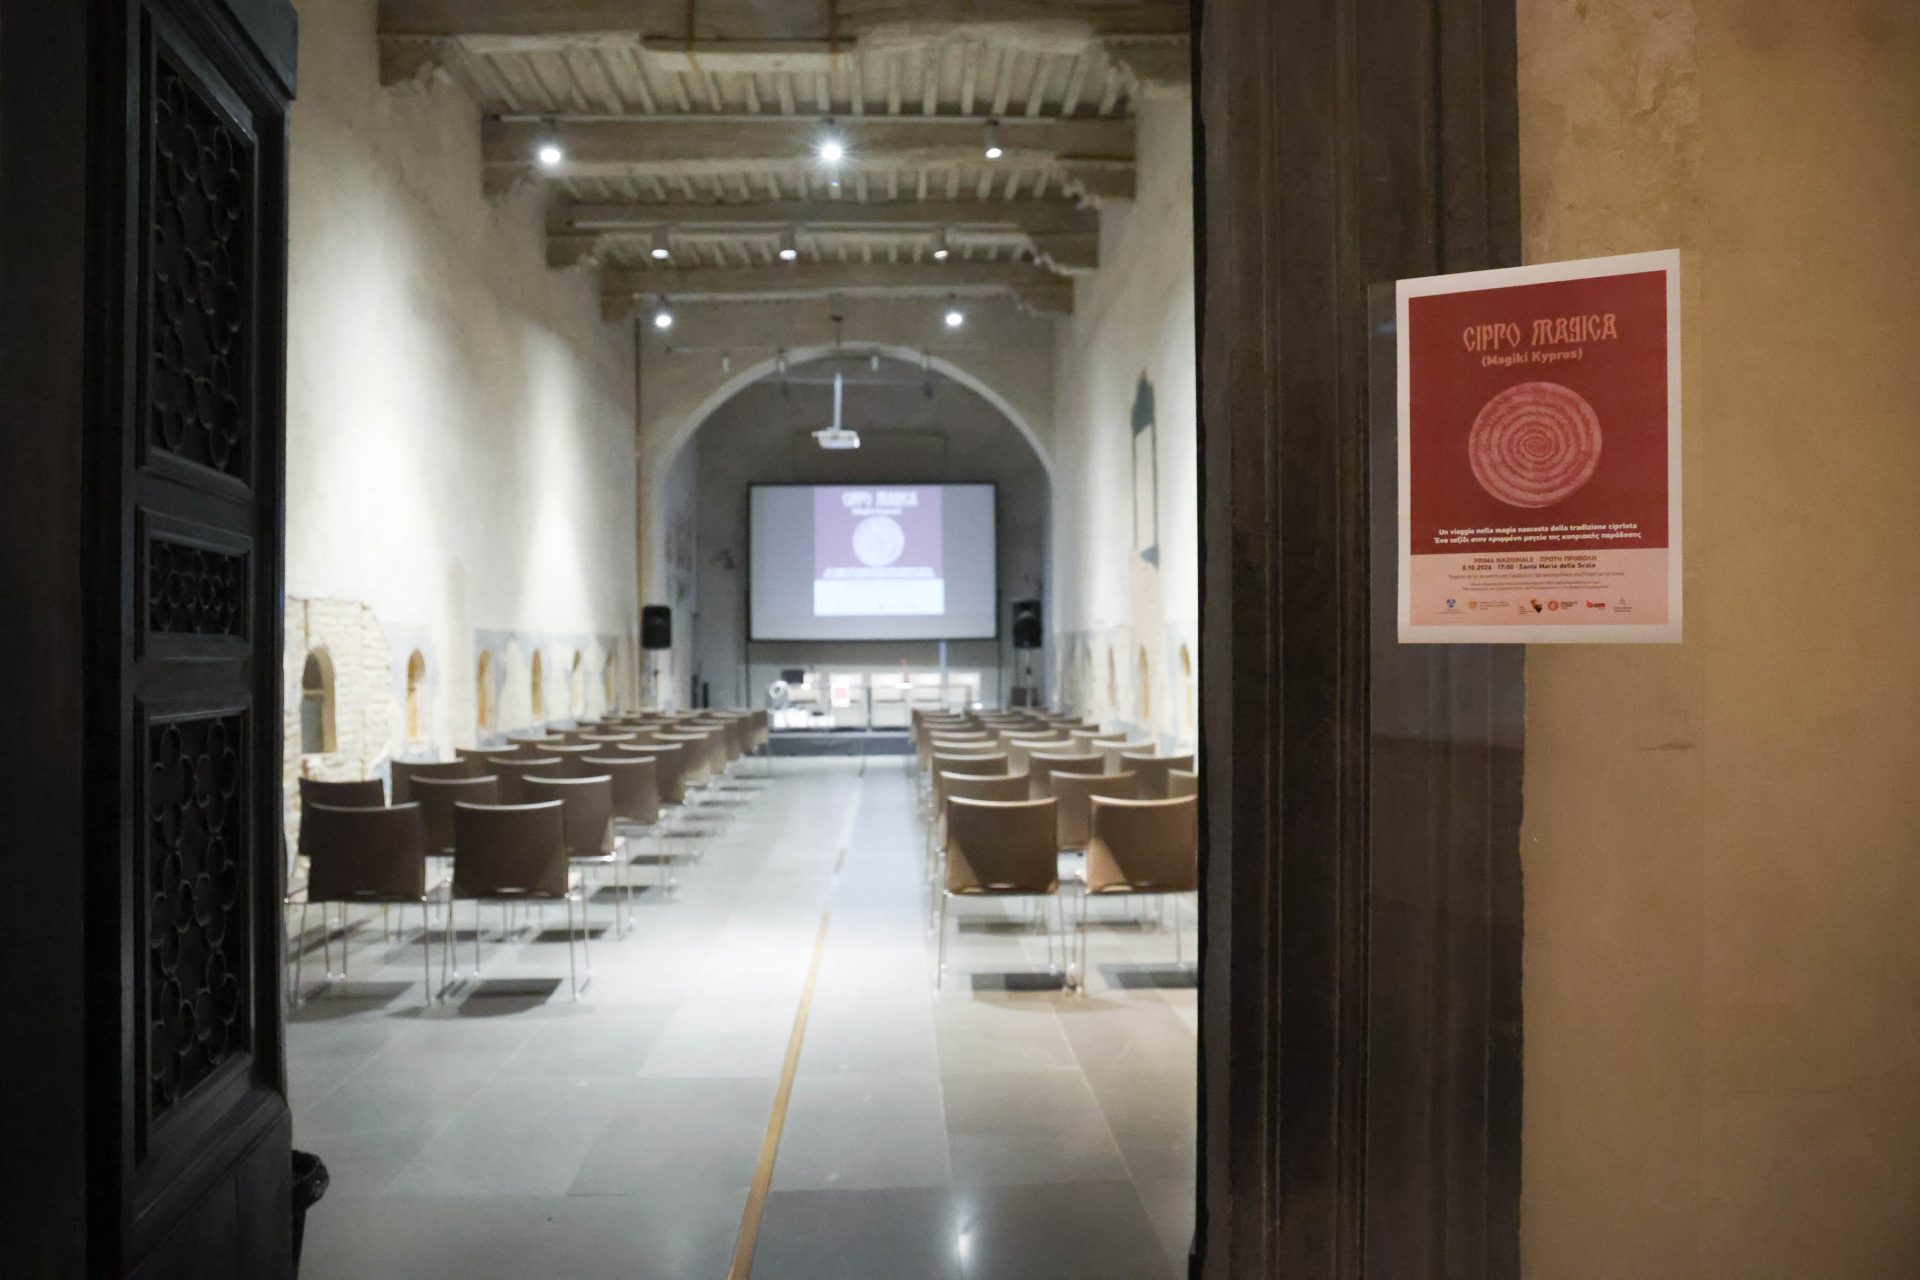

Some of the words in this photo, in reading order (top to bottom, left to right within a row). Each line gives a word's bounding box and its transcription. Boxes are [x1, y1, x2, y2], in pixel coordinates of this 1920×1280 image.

[1531, 313, 1618, 346] MAGICA
[1481, 352, 1528, 367] (Magiki
[1531, 347, 1584, 363] Kypros)
